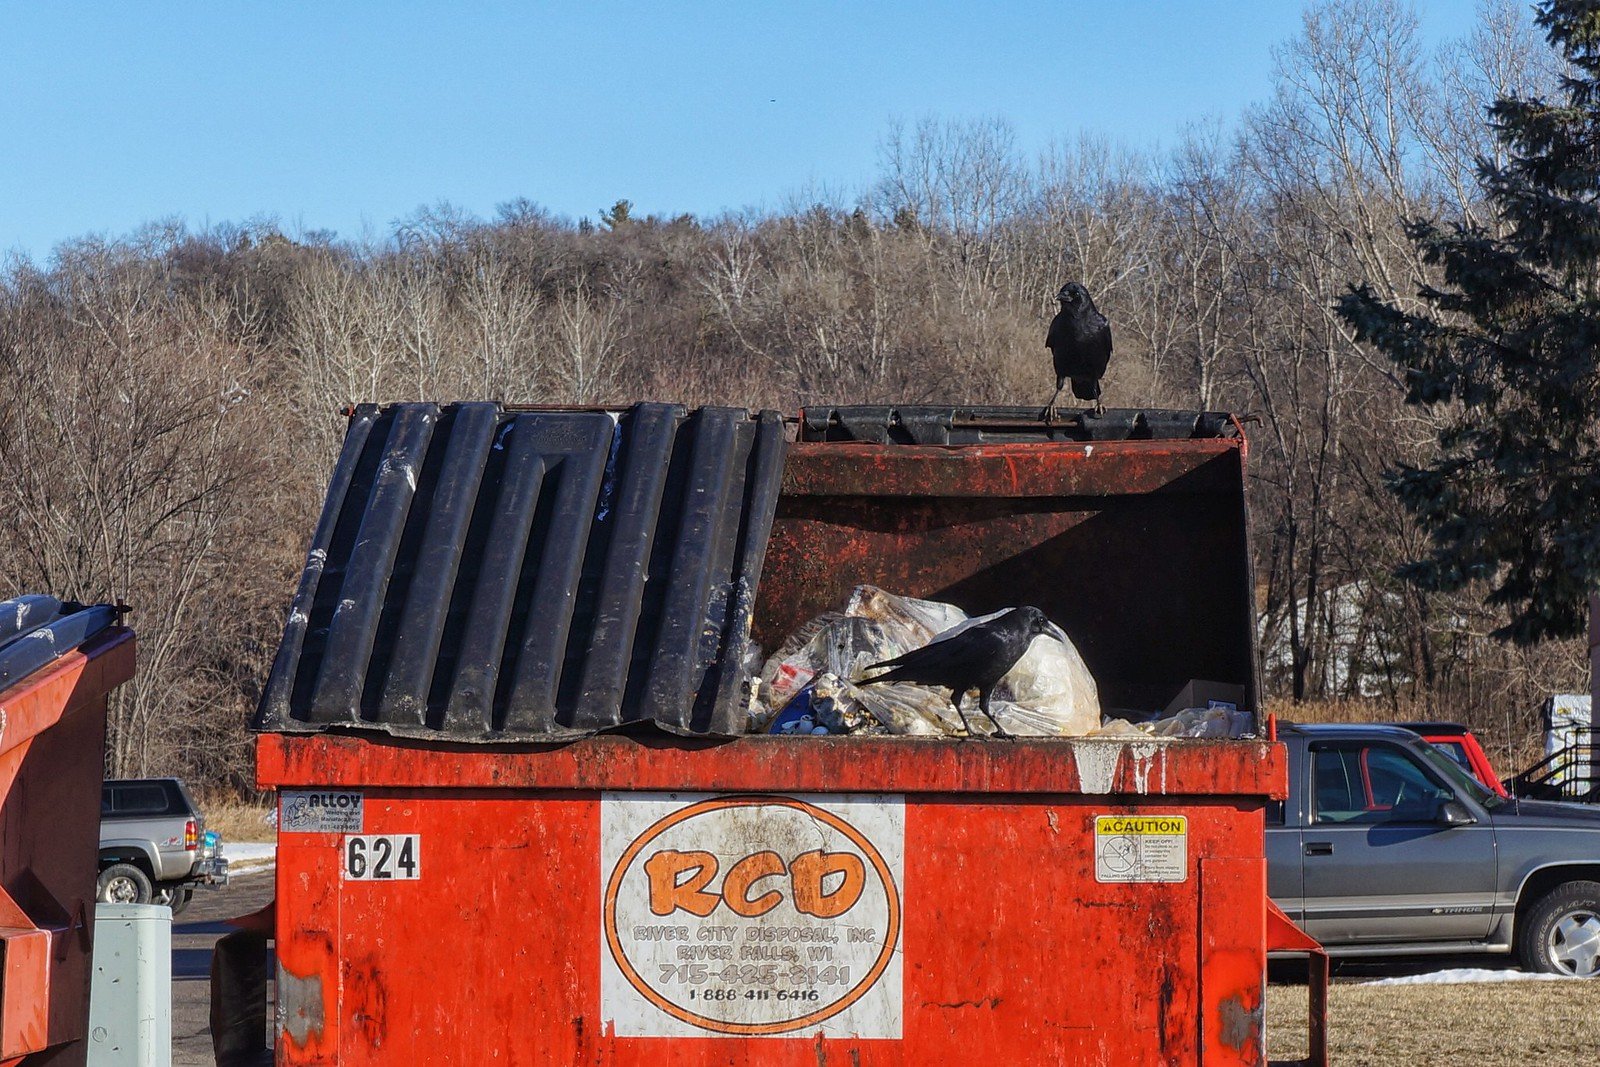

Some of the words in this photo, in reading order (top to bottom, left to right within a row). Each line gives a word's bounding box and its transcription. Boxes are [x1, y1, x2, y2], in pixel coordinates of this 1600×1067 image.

[309, 794, 361, 808] ALLOY
[1113, 821, 1181, 832] CAUTION
[348, 836, 416, 879] 624
[644, 850, 866, 919] RCD
[633, 926, 689, 941] RIVER
[696, 926, 738, 941] CITY
[745, 926, 839, 944] DISPOSAL,
[847, 929, 876, 943] INC
[676, 946, 733, 961] RIVER
[740, 946, 800, 962] FALLS,
[806, 946, 833, 961] WI
[658, 964, 851, 986] 715-425-2141
